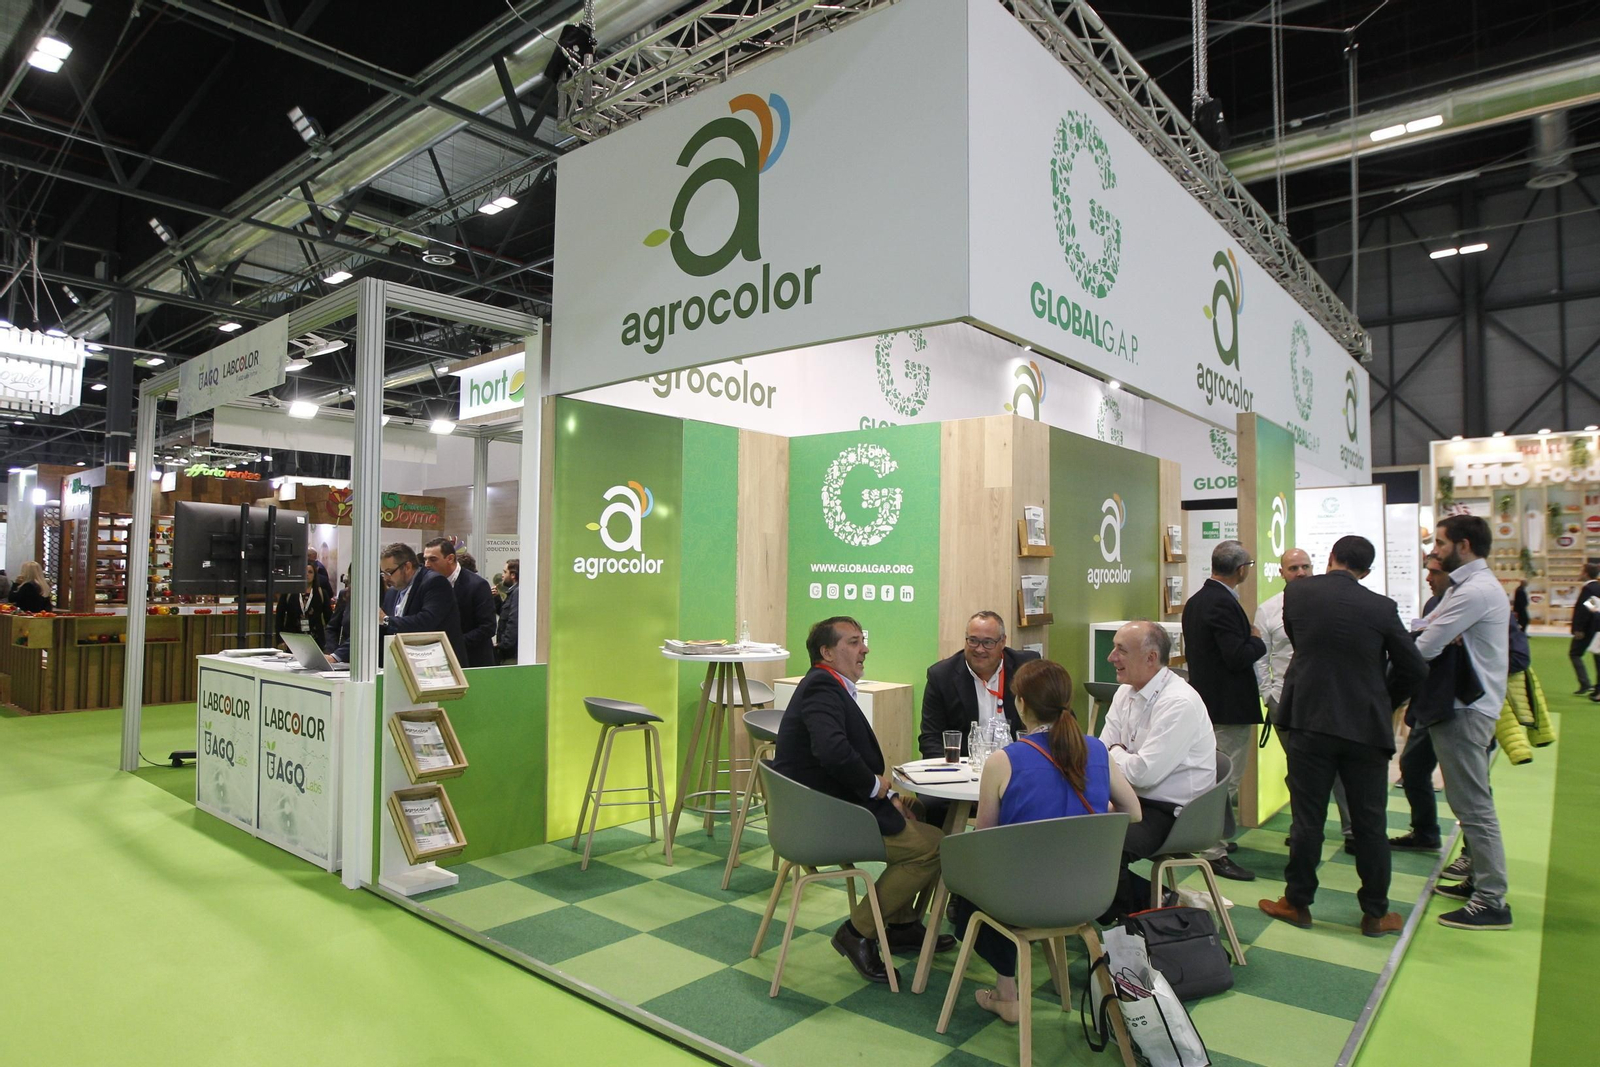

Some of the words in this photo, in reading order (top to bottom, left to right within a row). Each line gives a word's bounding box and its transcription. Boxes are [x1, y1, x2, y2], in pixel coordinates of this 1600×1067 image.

[621, 263, 820, 354] agrocolor
[222, 350, 259, 379] LABCOLOR
[636, 366, 776, 409] grocolor
[1197, 363, 1254, 412] agrocolor
[1340, 443, 1364, 471] agrocolor
[573, 553, 664, 580] agrocolor
[810, 563, 914, 574] WWW.GLOBALGAP.ORG
[1087, 567, 1132, 589] agrocolor
[203, 690, 250, 720] LABCOLOR
[264, 706, 325, 742] LABCOLOR
[212, 735, 235, 767] AGQ
[276, 757, 305, 793] AGQ
